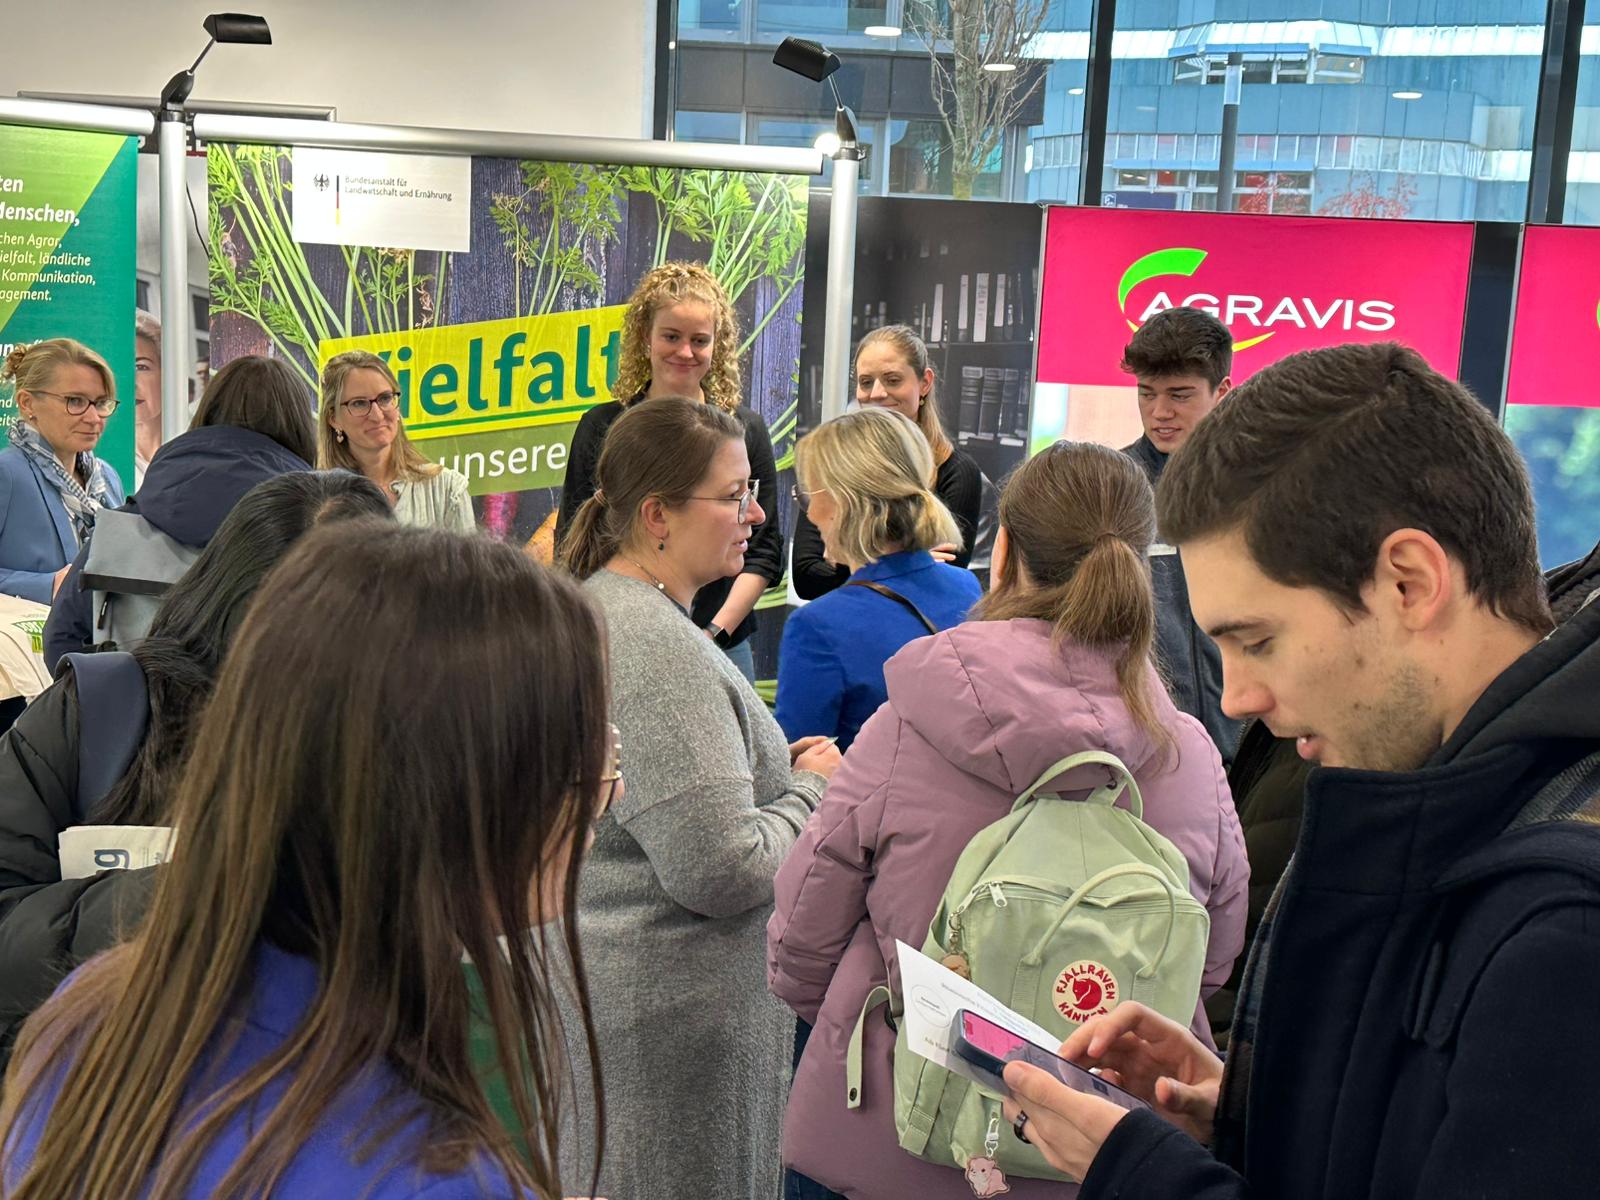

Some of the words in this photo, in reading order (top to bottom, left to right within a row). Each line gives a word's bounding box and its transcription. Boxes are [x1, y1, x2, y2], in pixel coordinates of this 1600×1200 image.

[397, 178, 408, 187] für
[400, 189, 413, 198] und
[415, 189, 452, 202] Ernährung
[39, 252, 91, 266] ländliche
[2, 268, 96, 286] Kommunikation,
[1139, 291, 1396, 332] AGRAVIS
[380, 325, 622, 419] ielfalt
